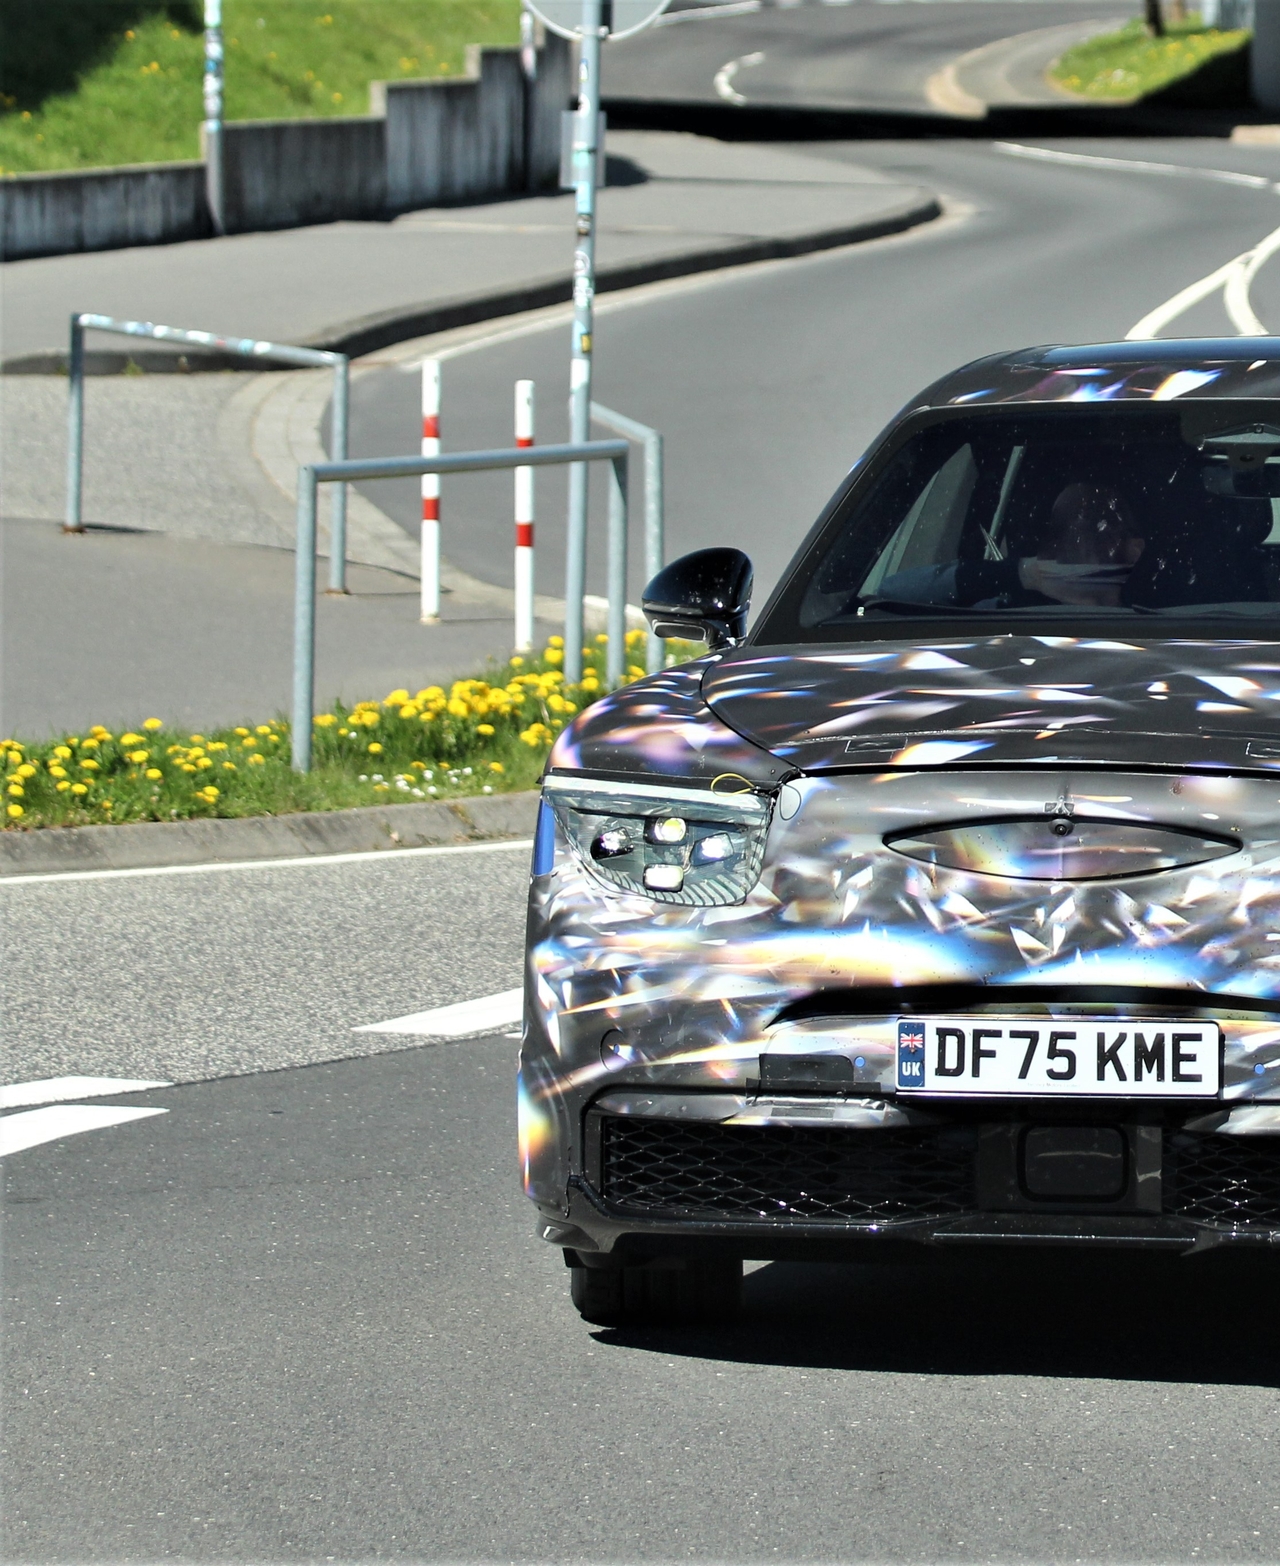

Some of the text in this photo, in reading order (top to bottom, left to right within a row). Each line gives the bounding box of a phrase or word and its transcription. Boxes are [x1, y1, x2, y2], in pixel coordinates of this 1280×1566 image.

[902, 1060, 921, 1077] UK
[935, 1027, 1203, 1082] DF75 KME
